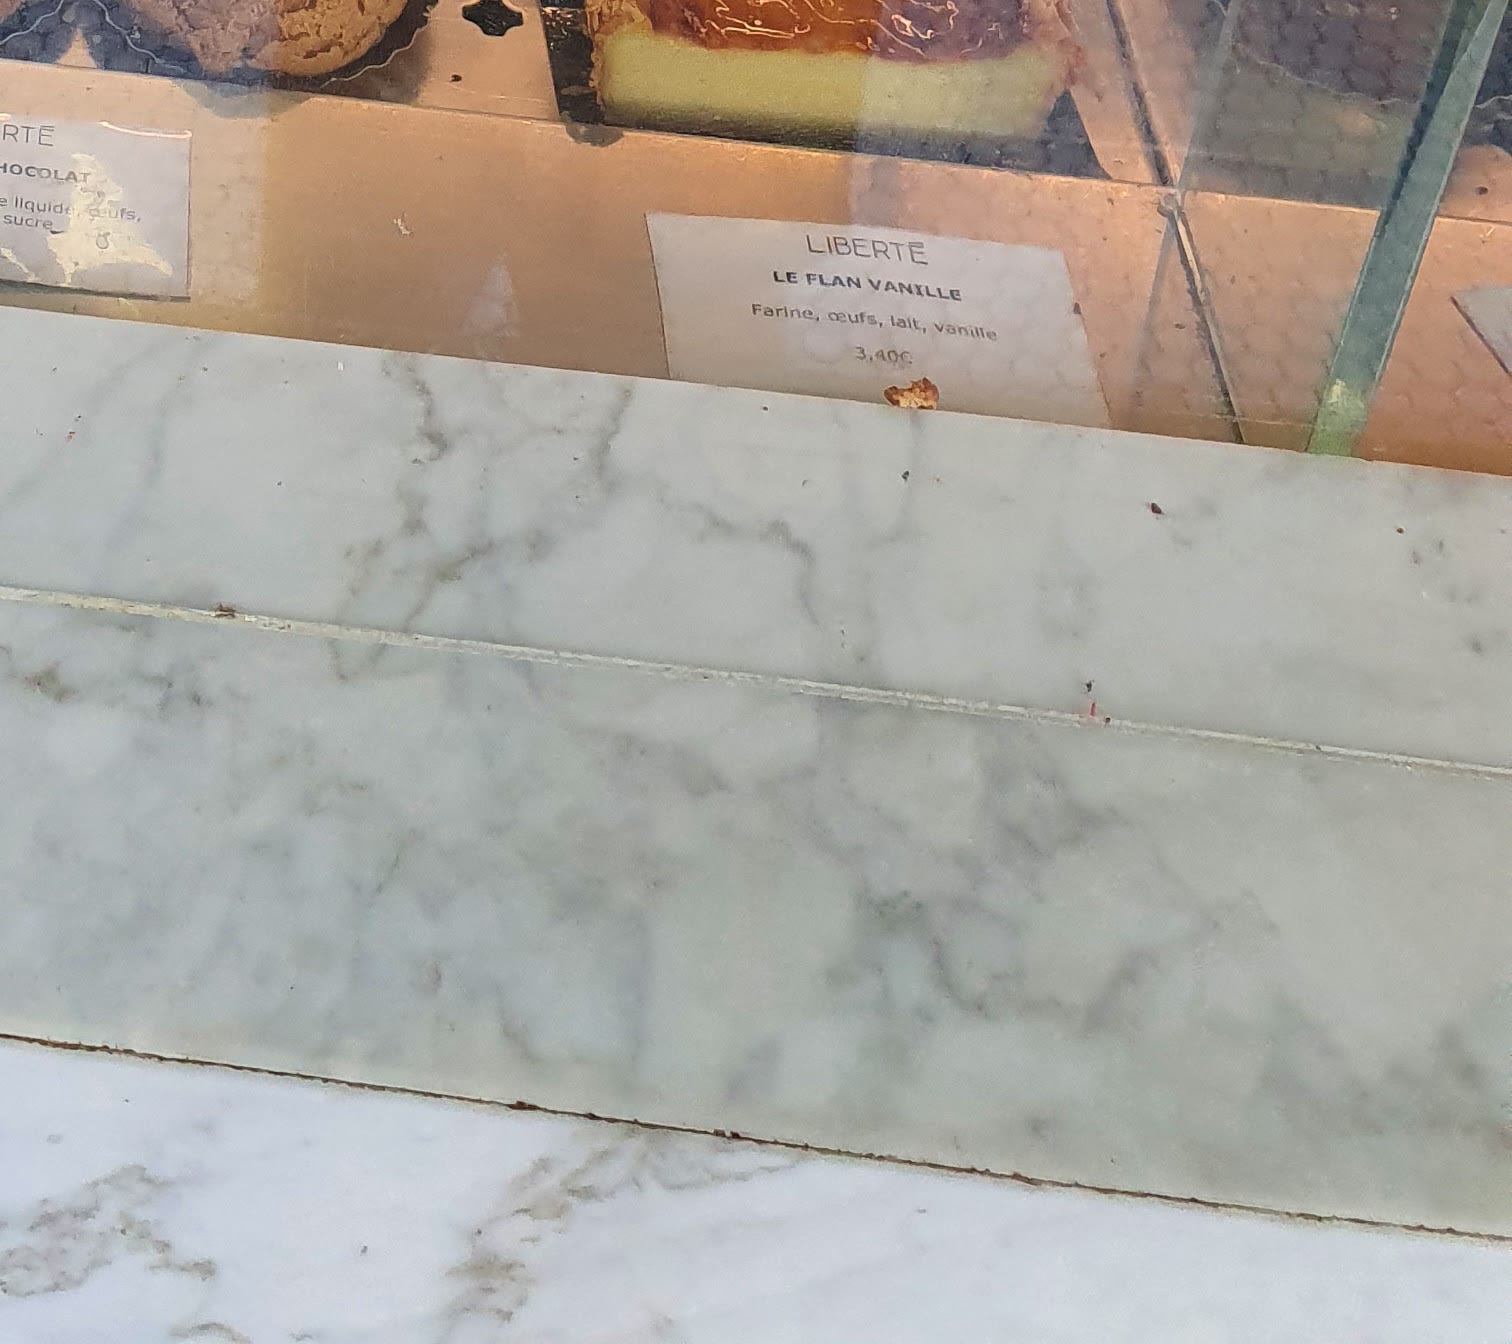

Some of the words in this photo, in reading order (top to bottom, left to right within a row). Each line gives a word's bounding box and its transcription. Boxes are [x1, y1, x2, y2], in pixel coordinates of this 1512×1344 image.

[3, 214, 53, 230] sucre
[773, 270, 798, 284] LE
[806, 273, 862, 290] FLAN
[867, 278, 963, 301] VANILLE
[751, 303, 820, 322] Farine,
[828, 311, 883, 328] œufs,
[890, 315, 926, 334] lait,
[933, 322, 998, 342] vanille
